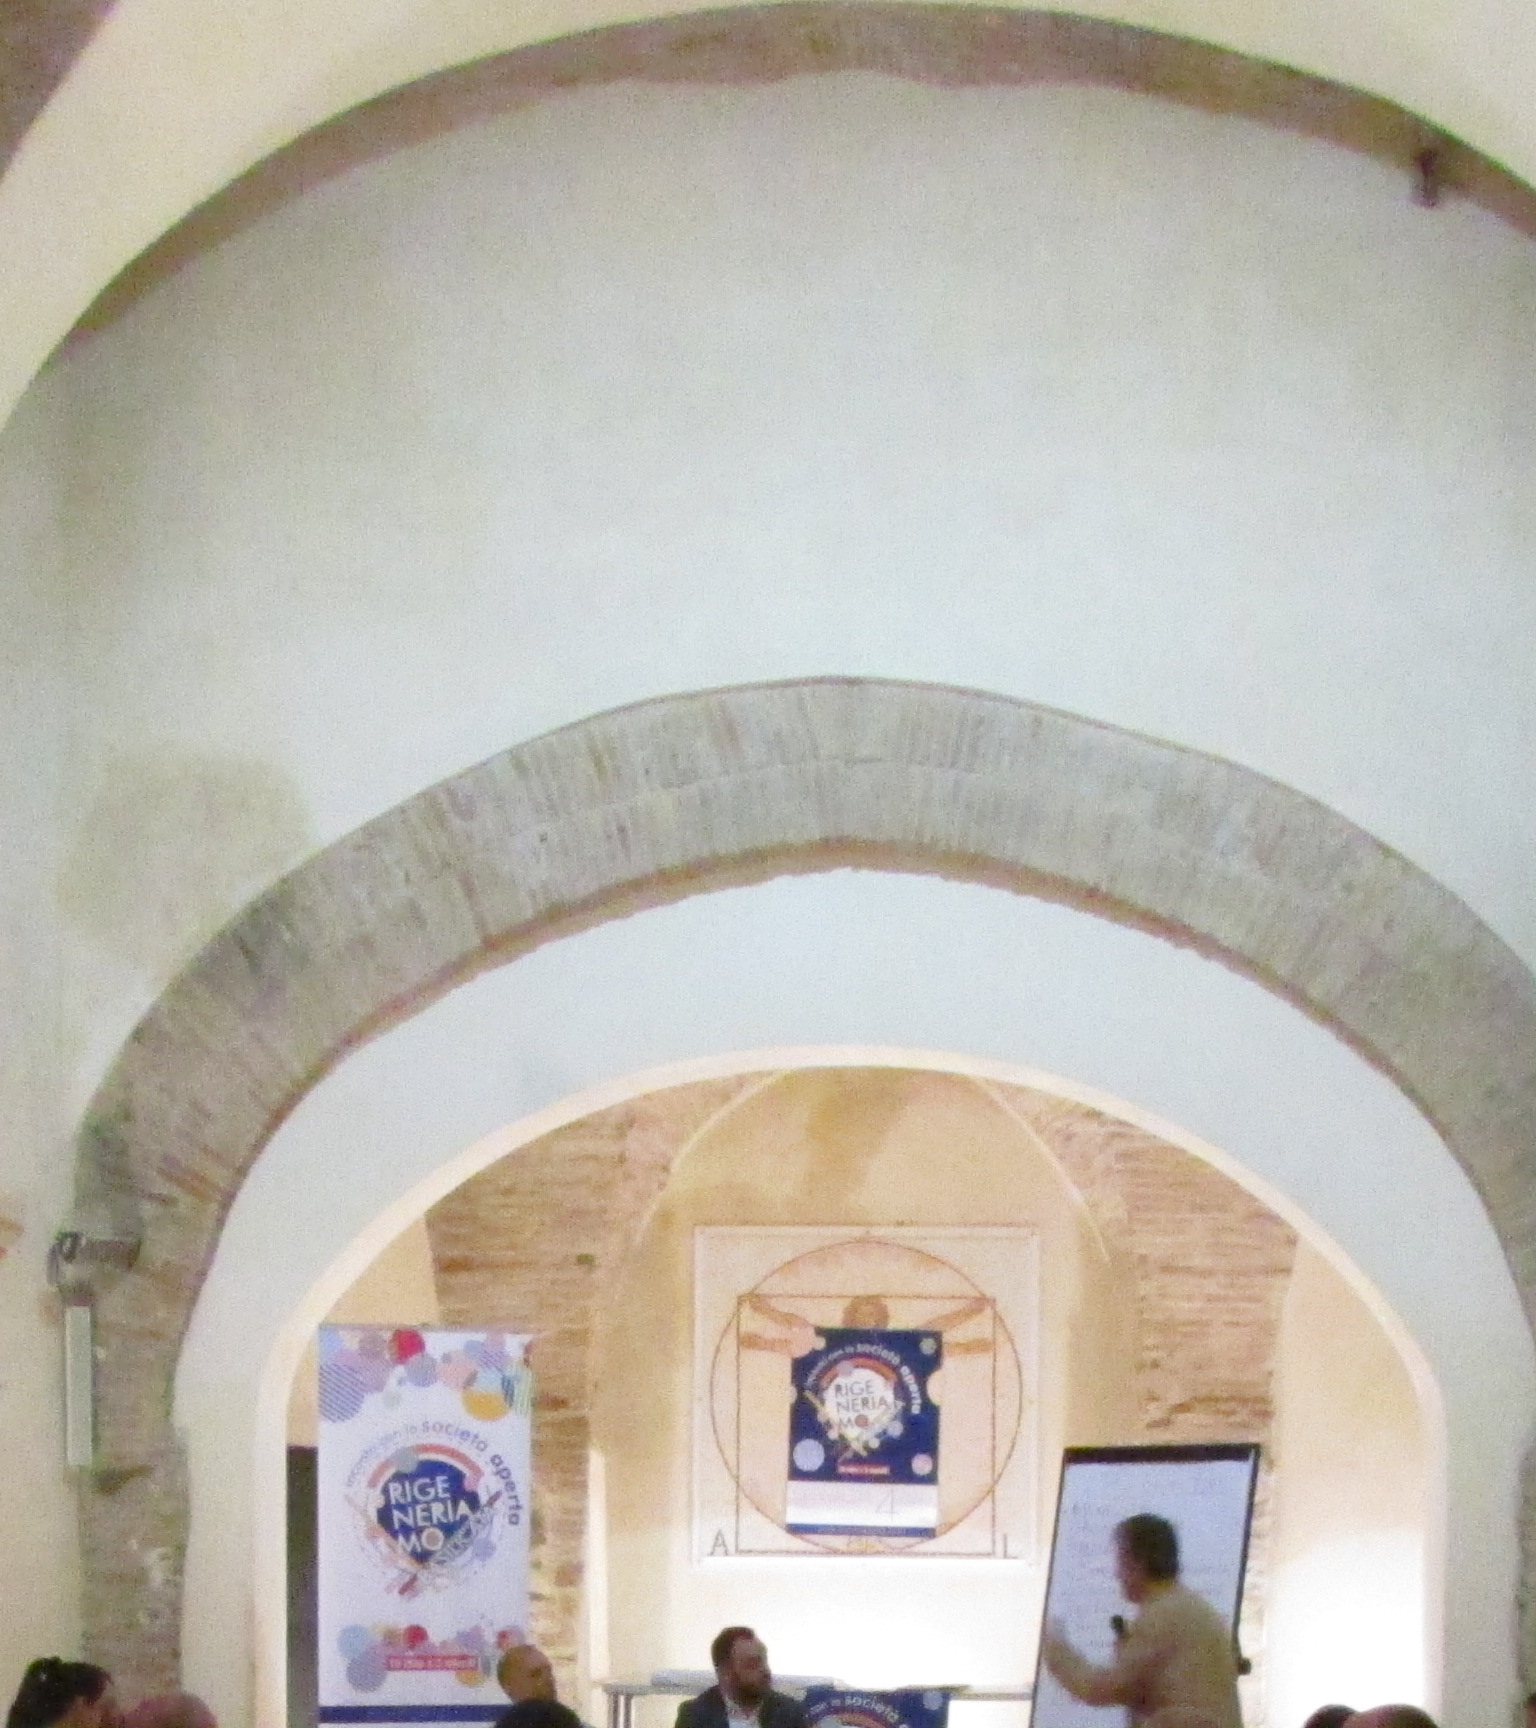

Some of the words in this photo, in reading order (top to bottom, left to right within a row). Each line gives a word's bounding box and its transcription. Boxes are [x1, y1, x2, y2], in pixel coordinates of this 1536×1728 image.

[834, 1379, 875, 1396] RIGE
[835, 1397, 888, 1413] NERIA
[388, 1475, 451, 1506] RIGE
[489, 1453, 522, 1526] aperta
[391, 1499, 472, 1531] NERIA
[397, 1527, 445, 1553] MO
